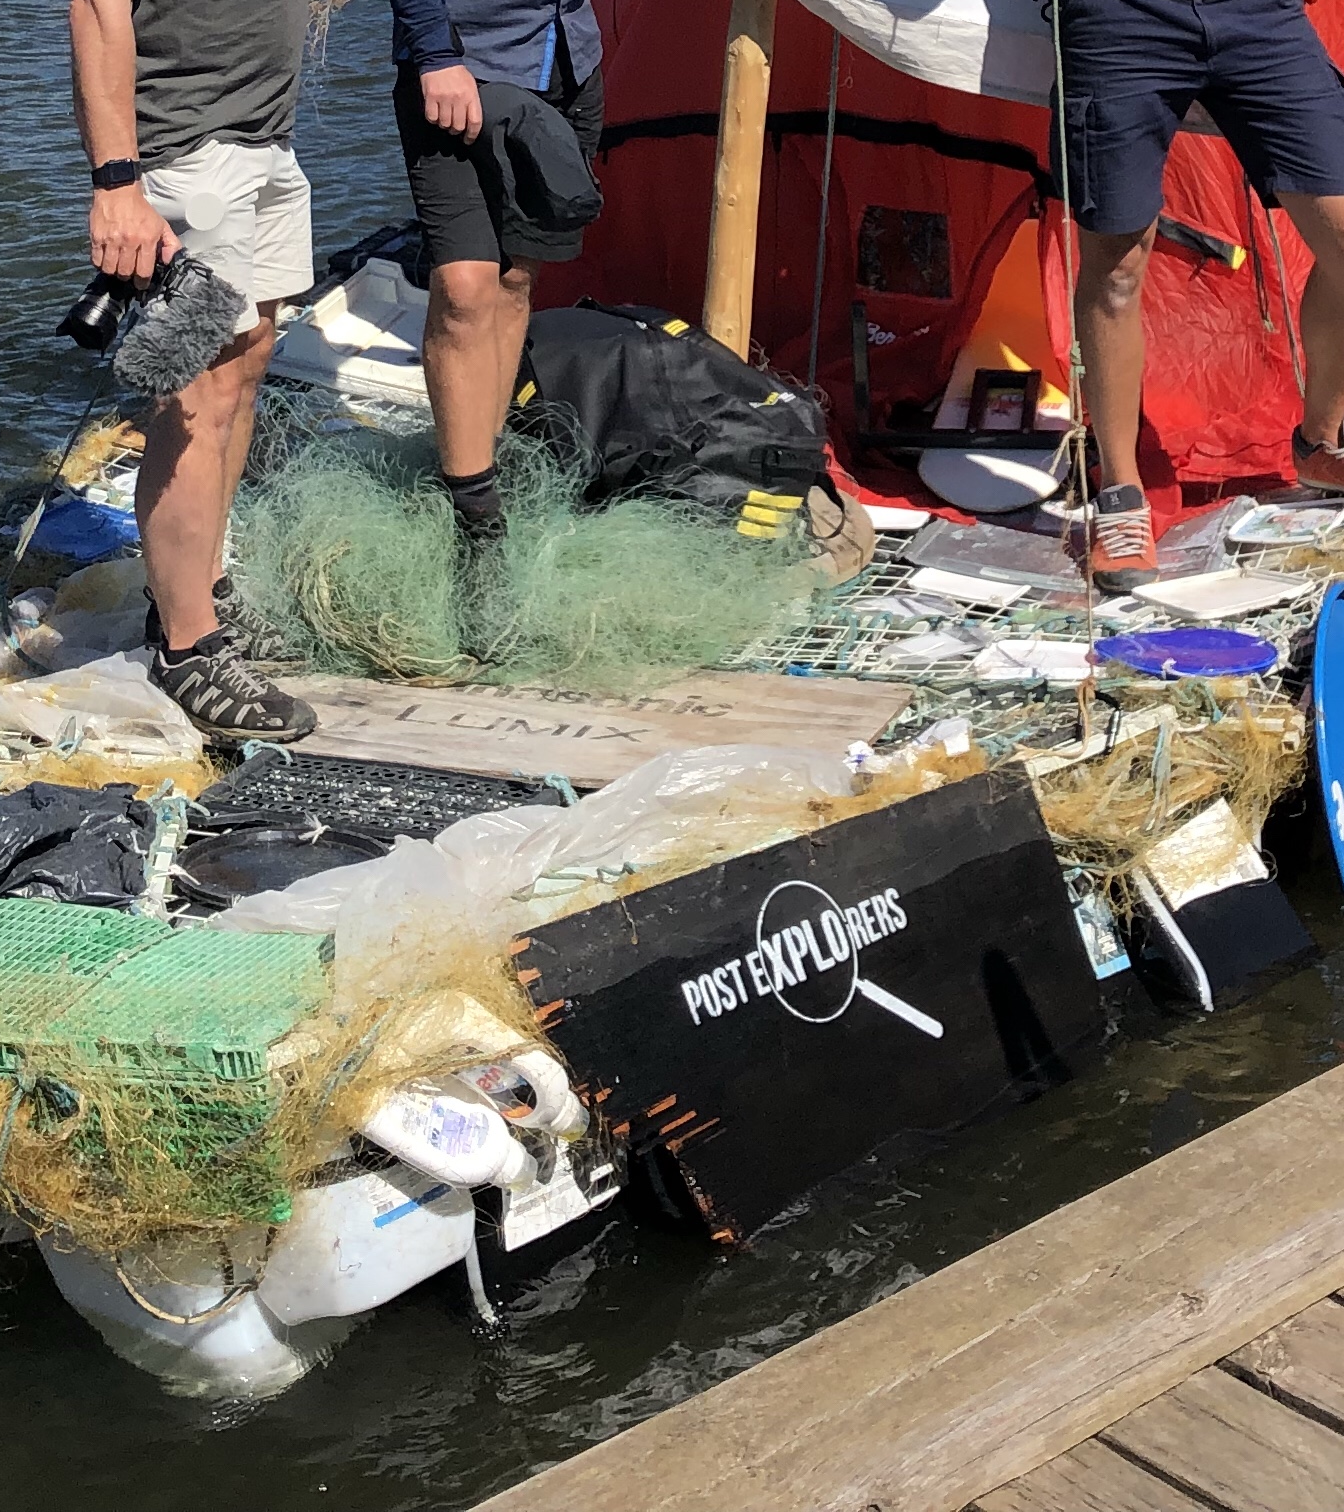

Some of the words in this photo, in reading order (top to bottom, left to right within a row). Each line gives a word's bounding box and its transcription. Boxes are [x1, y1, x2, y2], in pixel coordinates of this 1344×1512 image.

[394, 704, 653, 744] LUMIX
[680, 958, 749, 1026] POST
[745, 888, 908, 997] EXPLORERS
